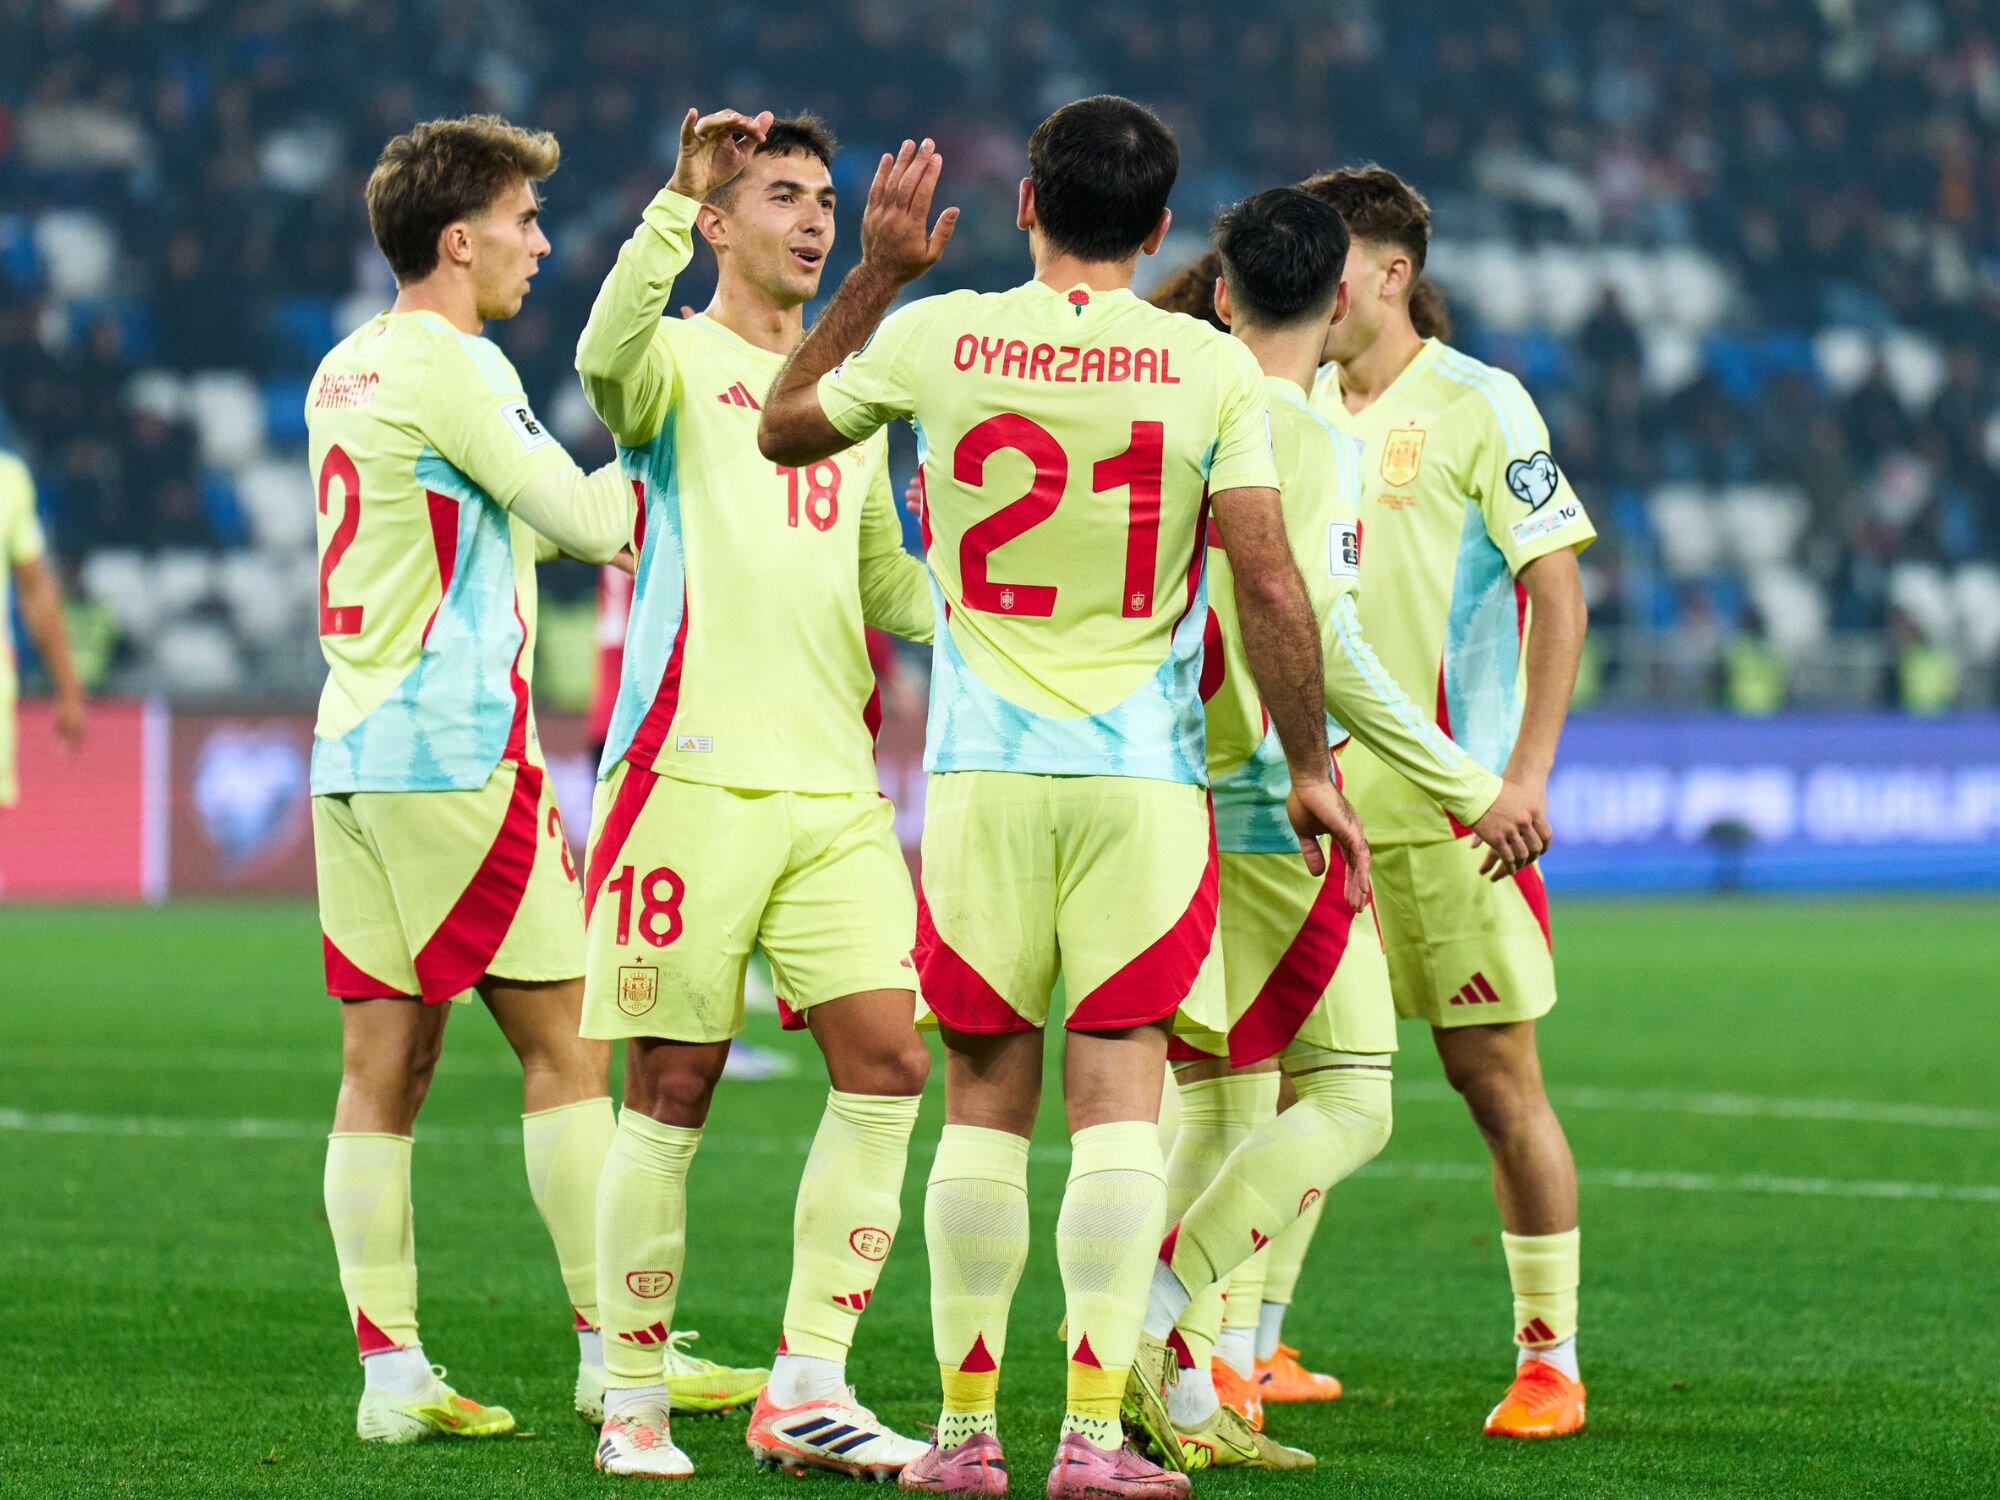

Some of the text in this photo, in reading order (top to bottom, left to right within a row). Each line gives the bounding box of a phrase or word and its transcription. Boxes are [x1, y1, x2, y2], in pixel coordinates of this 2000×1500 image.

[953, 333, 1181, 384] OYARZABAL
[775, 457, 842, 532] 18
[953, 412, 1164, 618] 21
[318, 443, 364, 636] 2
[608, 865, 686, 948] 18
